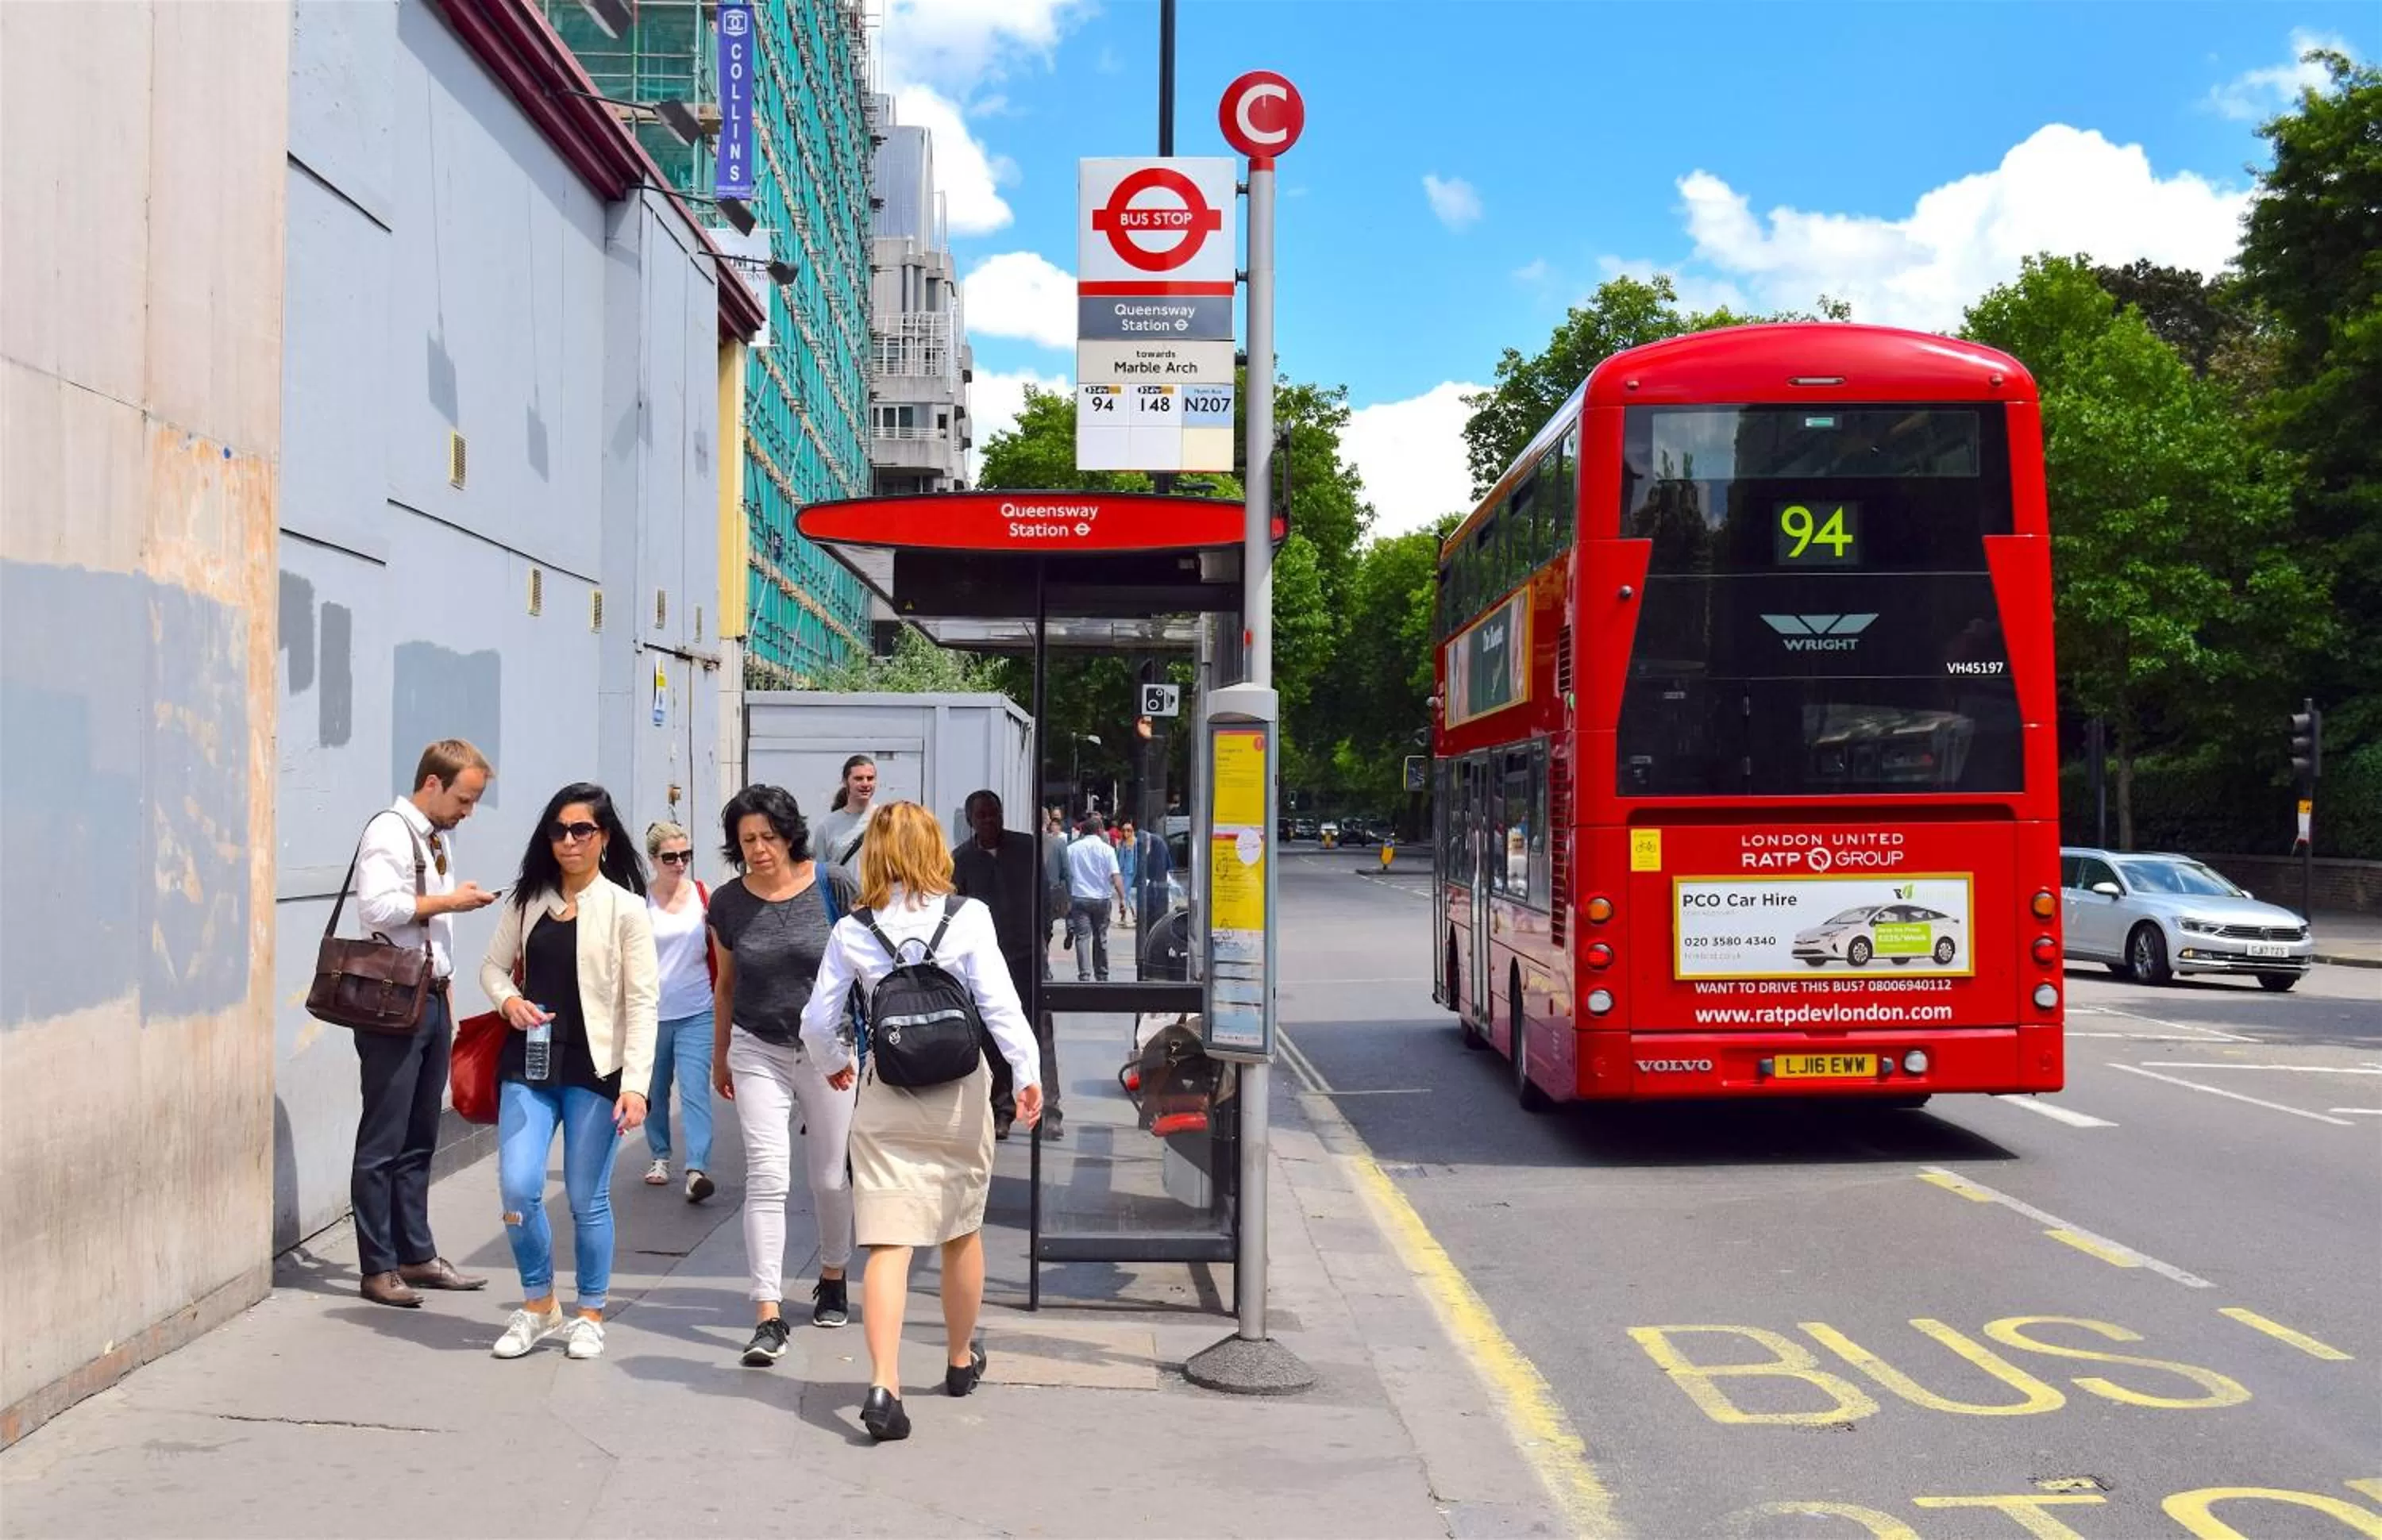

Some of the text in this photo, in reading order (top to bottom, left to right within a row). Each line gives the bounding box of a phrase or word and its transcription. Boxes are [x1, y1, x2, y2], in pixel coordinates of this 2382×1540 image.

[729, 43, 743, 182] COLLINS
[1235, 83, 1288, 144] C
[1120, 211, 1193, 225] BUS STOP
[1114, 303, 1195, 318] Queensway
[1121, 318, 1170, 331] Station
[1114, 361, 1198, 374] Marble Arch
[1092, 396, 1114, 411] 94
[1140, 396, 1170, 412] 148
[1185, 397, 1231, 412] N207
[1000, 502, 1099, 521] Queensway
[1009, 522, 1070, 537] Station
[1781, 505, 1854, 557] 94
[1783, 638, 1860, 651] WRIGHT
[1946, 661, 2004, 674] VH45197
[1741, 834, 1904, 847] LONDON UNITED
[1741, 850, 1905, 868] RATP GROUP
[1682, 892, 1798, 907] PCO Car Hire
[1684, 936, 1776, 947] 020 3580 4340
[1695, 979, 1952, 994] WANT TO DRIVE THIS BUS? 08006940112
[1695, 1003, 1952, 1026] www.ratpdevlondon.com
[1635, 1060, 1713, 1072] VOLVO
[1786, 1057, 1866, 1074] LJ16 EWW
[1626, 1314, 2253, 1427] BUS
